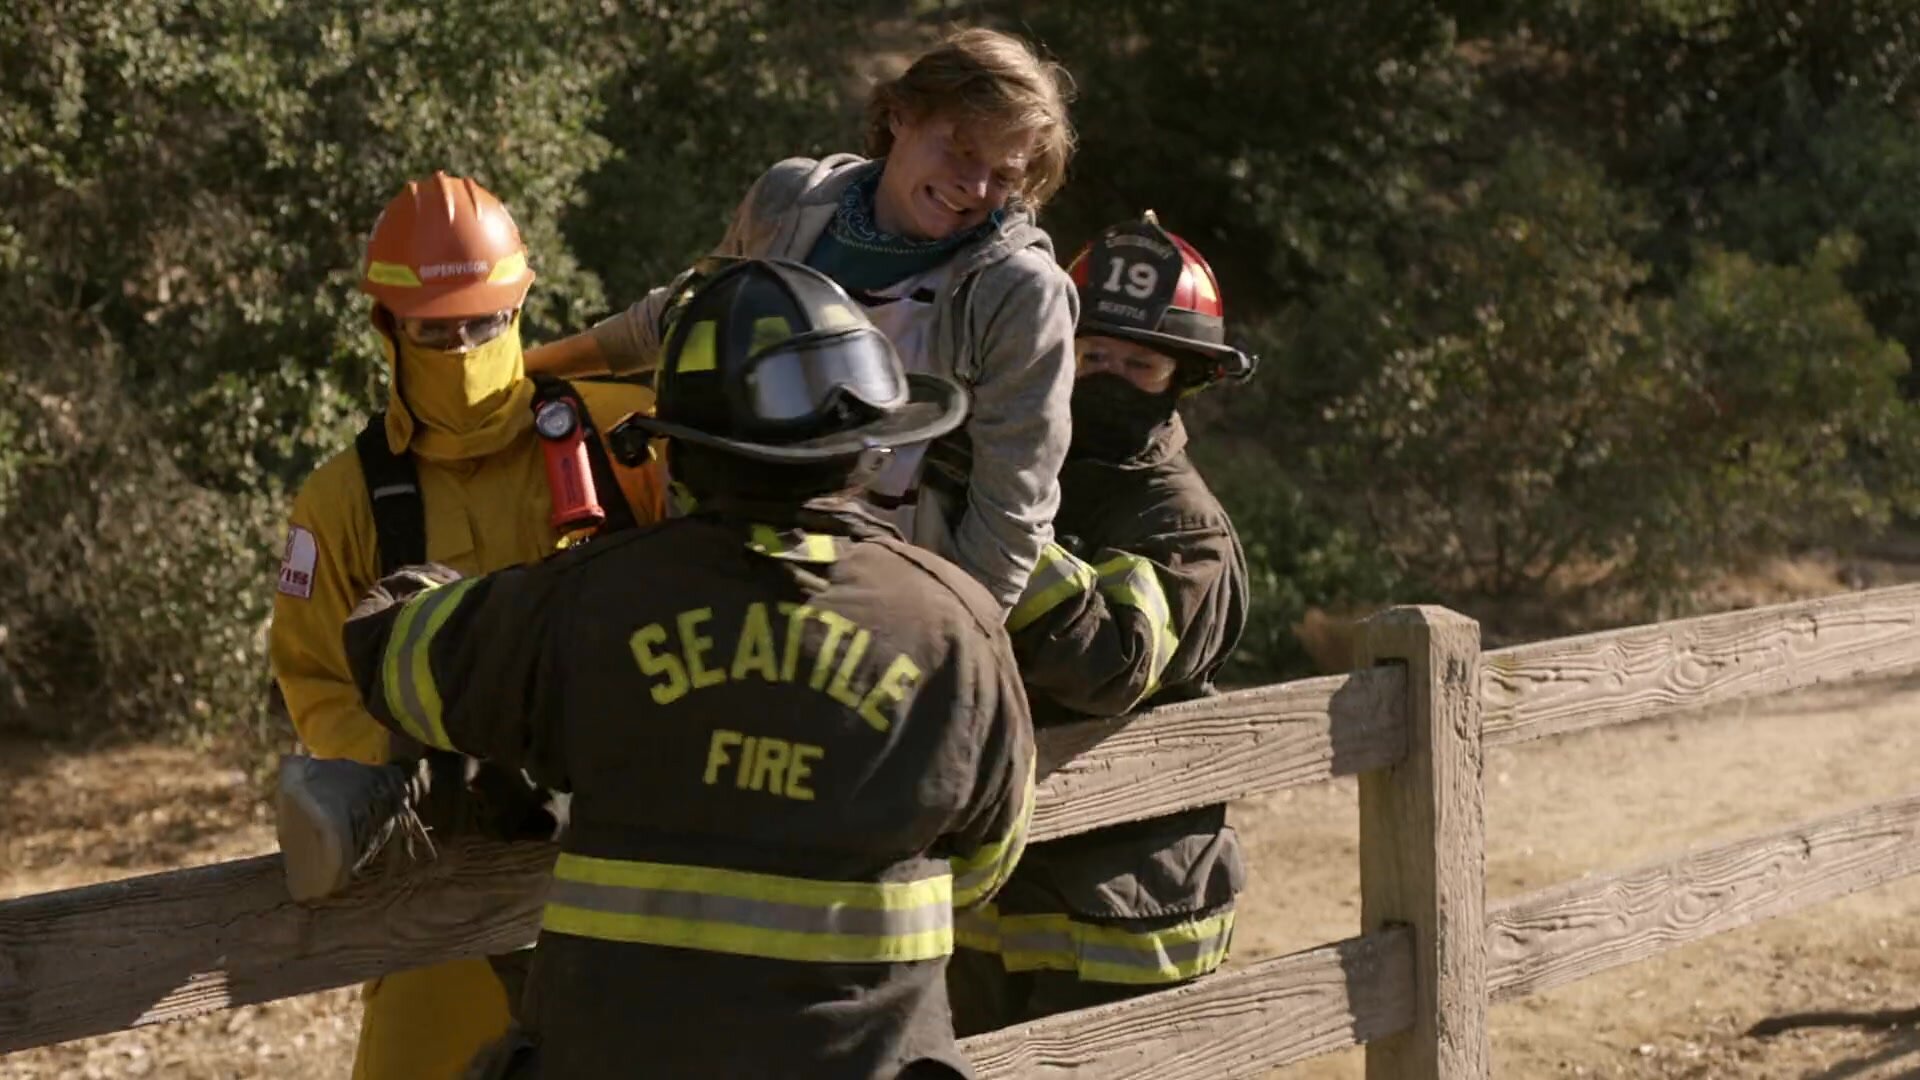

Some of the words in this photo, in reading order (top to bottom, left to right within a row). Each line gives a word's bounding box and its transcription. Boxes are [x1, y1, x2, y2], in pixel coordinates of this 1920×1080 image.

[419, 261, 488, 279] SUPERVISOR
[1103, 257, 1158, 299] 19
[629, 602, 921, 732] SEATTLE
[703, 729, 824, 800] FIRE
